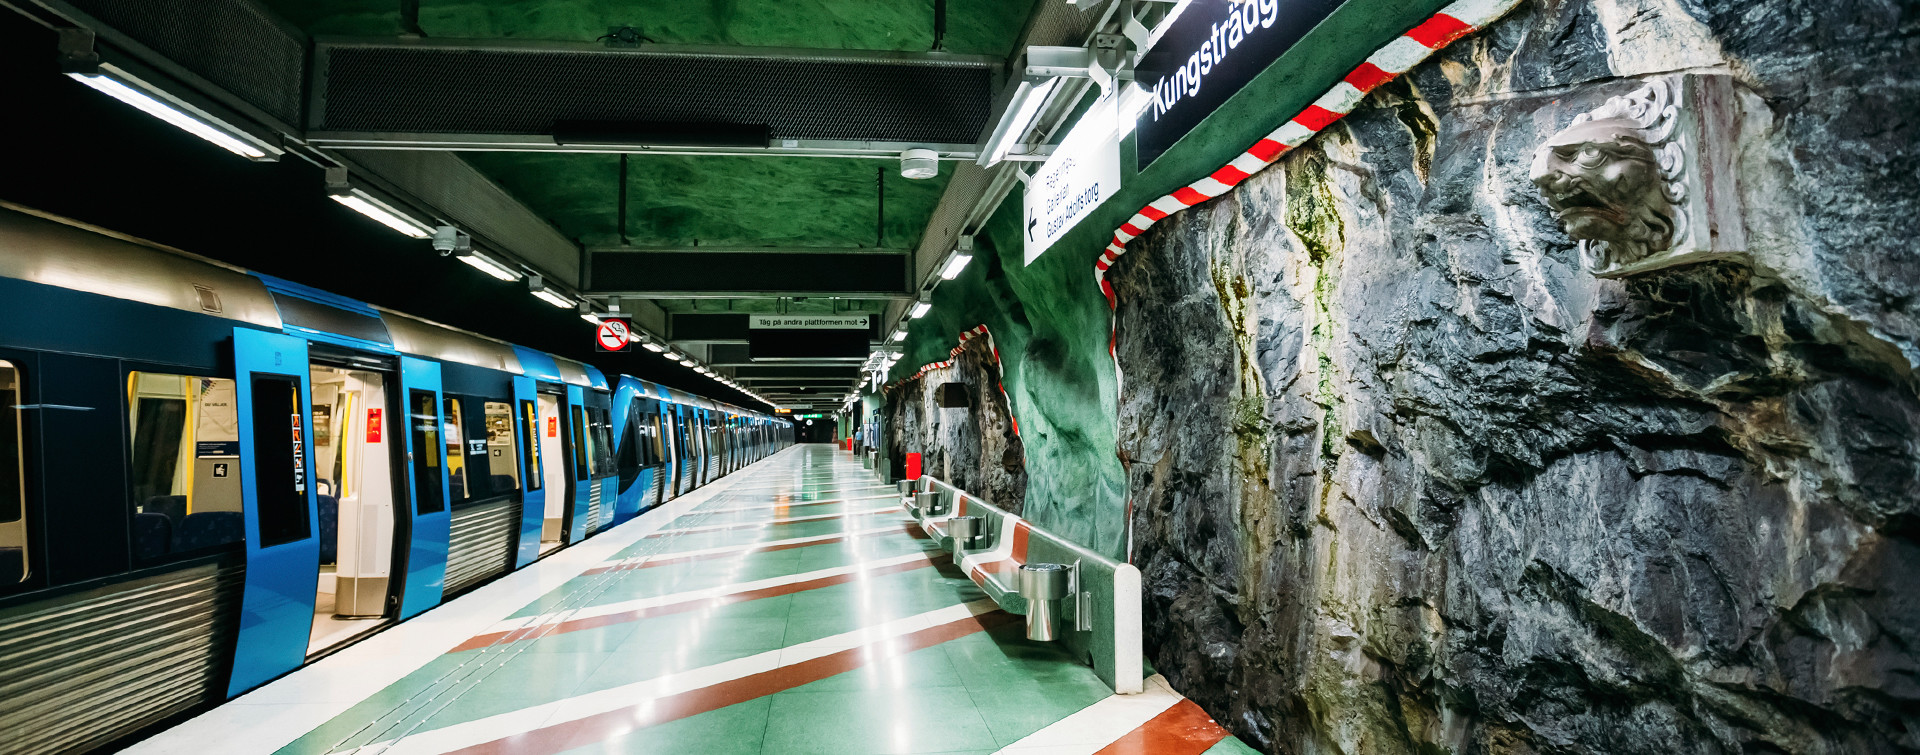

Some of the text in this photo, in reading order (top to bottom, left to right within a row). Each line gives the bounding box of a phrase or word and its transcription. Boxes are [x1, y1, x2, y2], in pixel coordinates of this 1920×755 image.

[1046, 182, 1099, 238] Gustav Adolfs torg
